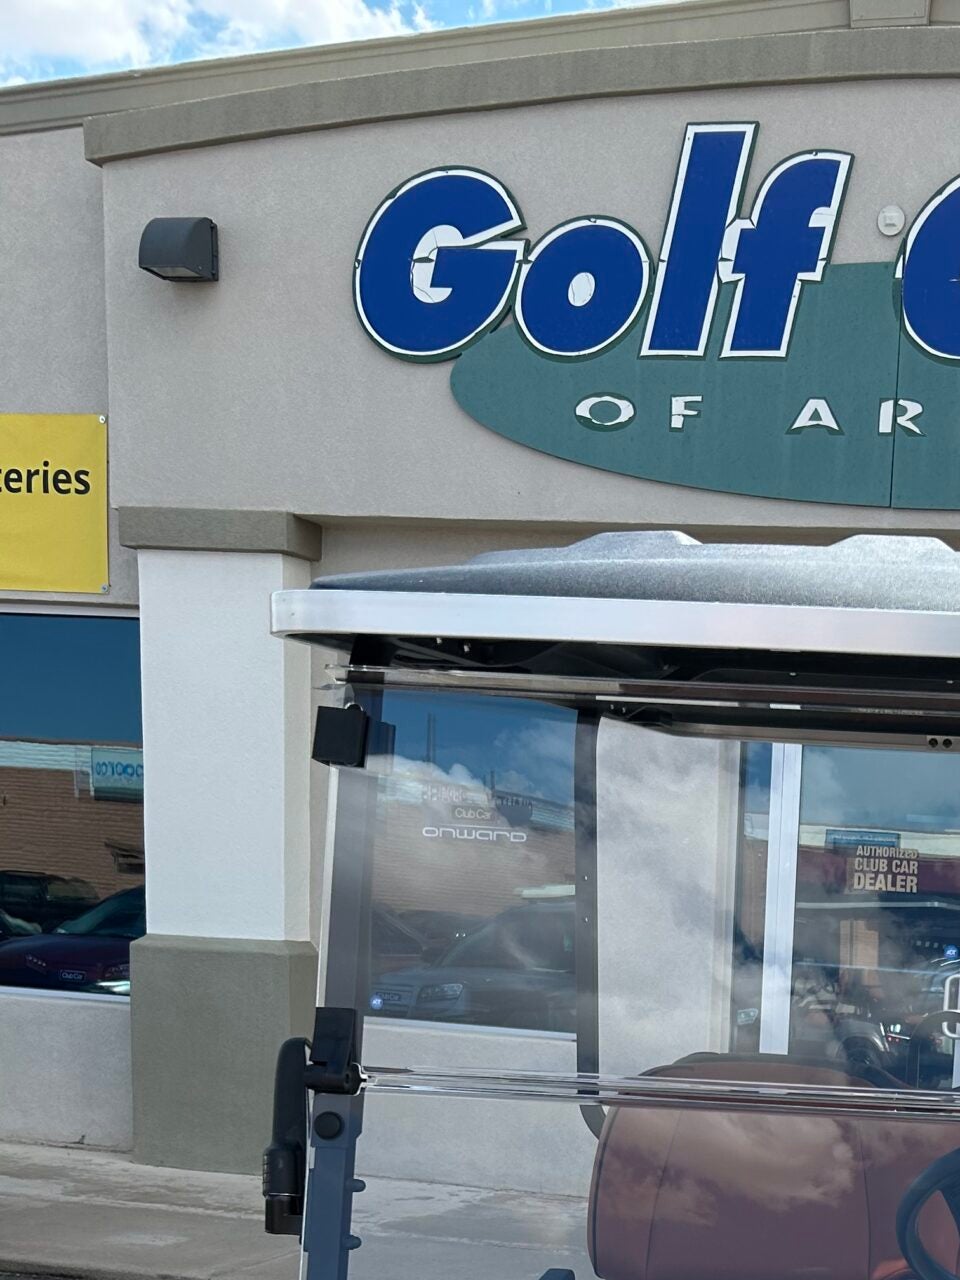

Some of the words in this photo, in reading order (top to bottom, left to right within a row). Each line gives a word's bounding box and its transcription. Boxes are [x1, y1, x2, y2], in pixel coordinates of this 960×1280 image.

[354, 121, 855, 362] Golf
[574, 395, 703, 430] OF
[0, 460, 91, 495] eries
[854, 857, 888, 873] CLUB
[892, 859, 918, 875] CAR
[856, 845, 919, 859] AUTHORIZED
[853, 872, 918, 893] DEALER
